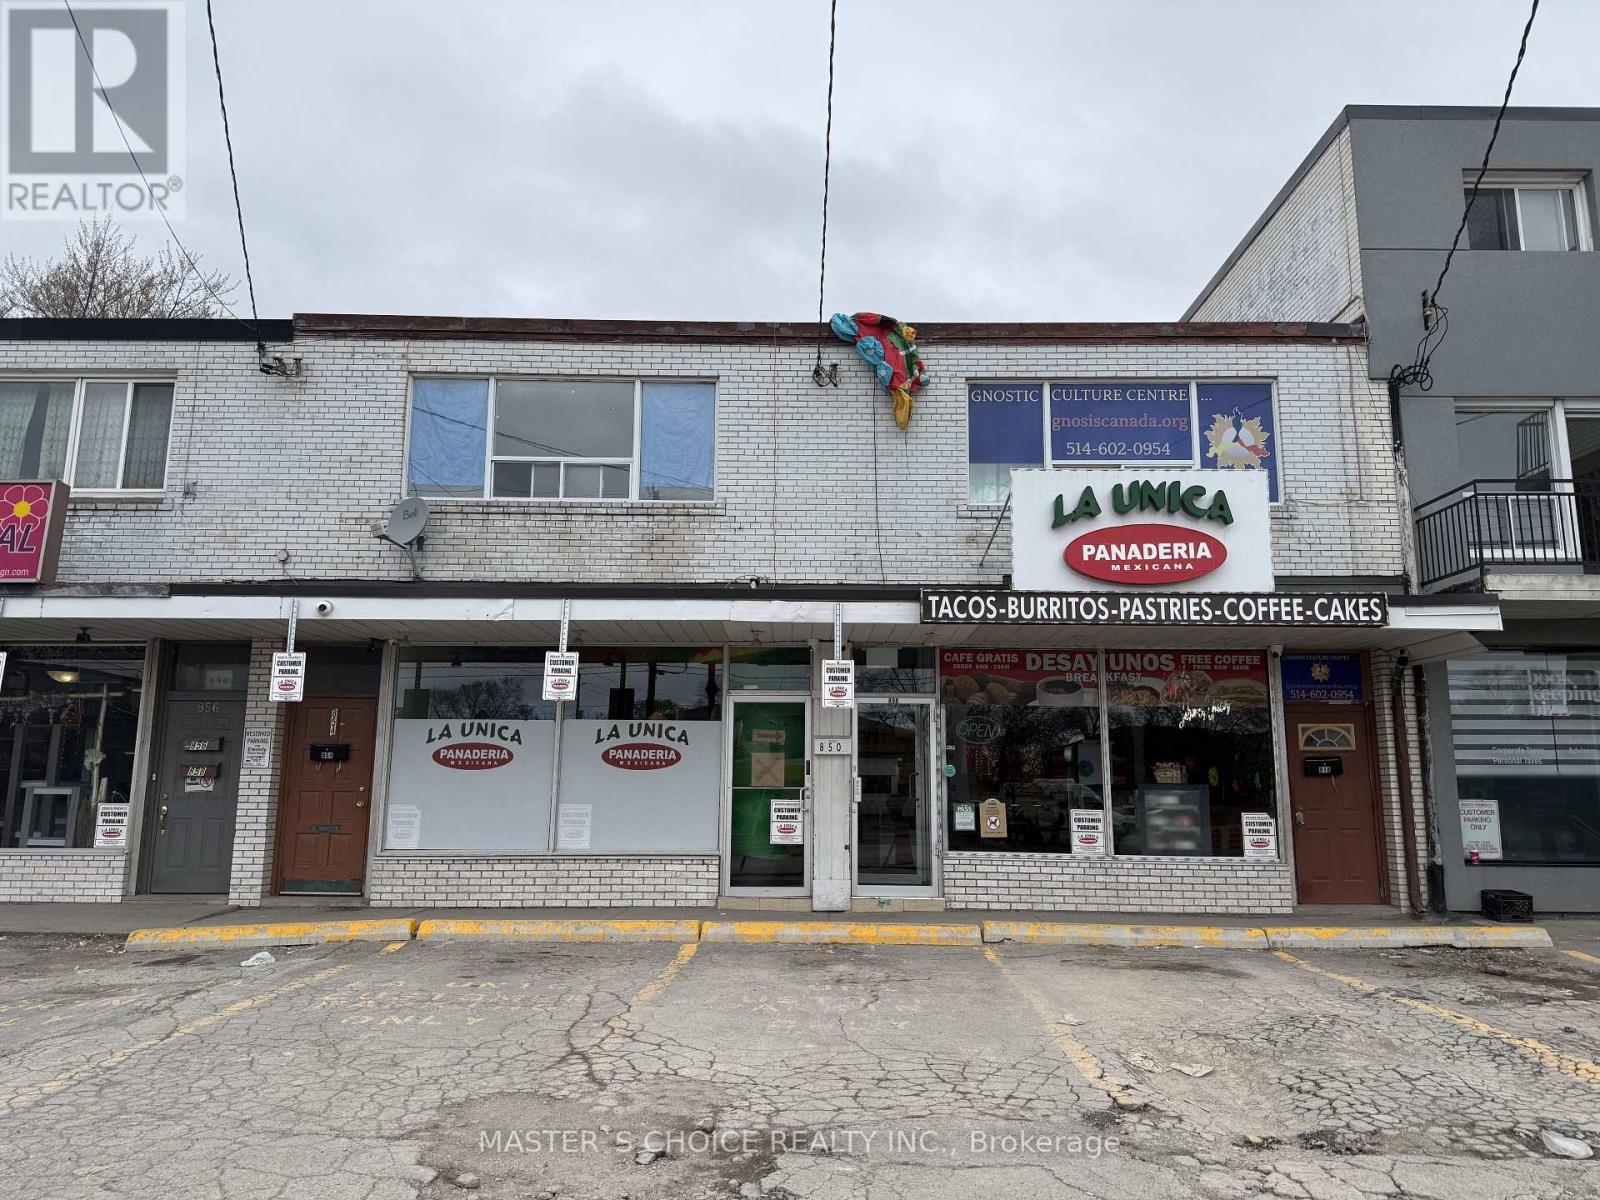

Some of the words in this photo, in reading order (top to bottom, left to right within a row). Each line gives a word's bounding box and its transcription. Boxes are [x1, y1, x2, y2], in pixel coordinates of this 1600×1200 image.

[971, 389, 1040, 402] GNOSTIC
[1051, 389, 1123, 401] CULTURE
[1126, 389, 1187, 401] CENTRE
[1052, 413, 1189, 431] gnosiscanada.org
[1066, 442, 1171, 456] 514-602-0954
[1052, 485, 1102, 529] LA
[1112, 479, 1234, 527] UNICA
[404, 507, 418, 520] Bell
[1082, 542, 1212, 561] PANADERIA
[1111, 563, 1194, 571] MEXICANA
[944, 652, 973, 663] CAFE
[976, 652, 1019, 663] GRATIS
[1026, 652, 1175, 671] DESAYUNOS
[1181, 655, 1211, 664] FREE
[1215, 655, 1260, 665] COFFEE
[1290, 689, 1354, 699] 514-602-0954
[426, 723, 452, 744] LA
[461, 722, 522, 745] UNICA
[595, 724, 620, 744] LA
[629, 723, 689, 746] UNICA
[958, 723, 996, 738] OPEN
[440, 749, 509, 760] PANADERIA
[609, 749, 676, 760] PANADERIA
